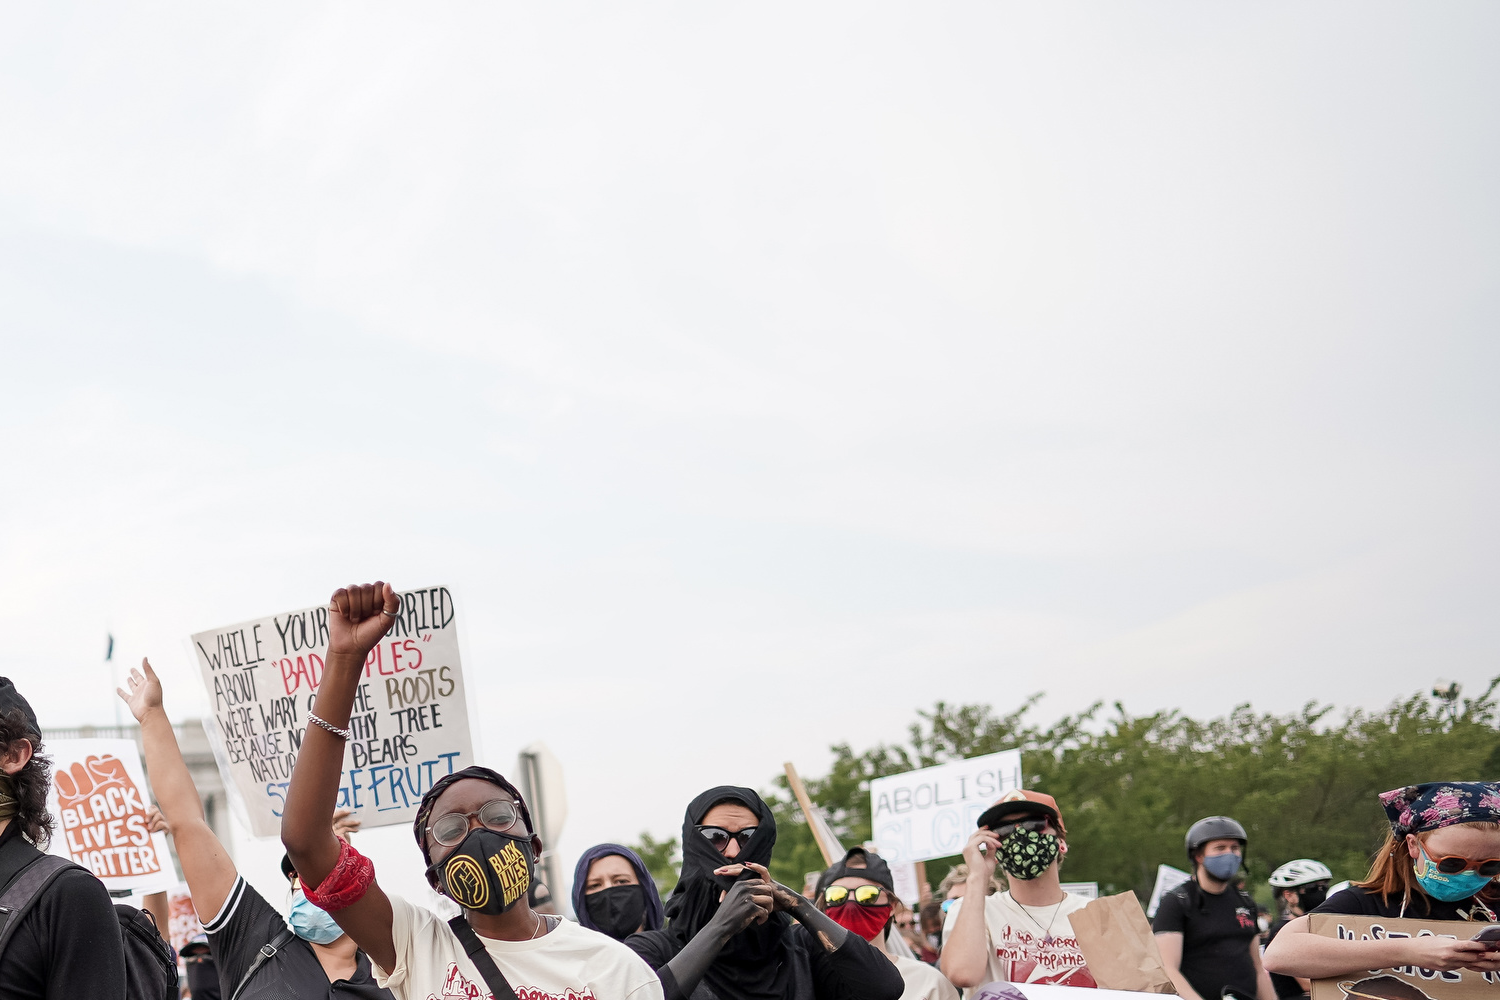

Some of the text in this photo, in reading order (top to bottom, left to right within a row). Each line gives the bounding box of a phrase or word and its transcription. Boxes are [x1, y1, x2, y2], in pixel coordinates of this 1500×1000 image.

[197, 624, 265, 671] WHILE
[213, 665, 258, 711] ABOUT
[260, 694, 298, 732] WARY
[353, 683, 375, 713] HE
[385, 666, 455, 710] ROOTS
[224, 731, 282, 765] BECAUSE
[391, 703, 443, 735] TREE
[351, 734, 418, 769] BEARS
[62, 786, 144, 830] BLACK
[876, 766, 1018, 817] ABOLISH
[66, 814, 150, 853] LIVES
[72, 846, 160, 876] MATTER
[488, 840, 523, 875] BLACK
[498, 856, 529, 889] LIVES
[503, 876, 530, 906] MATTER
[996, 947, 1028, 960] won't
[1060, 952, 1084, 966] the
[1016, 931, 1033, 945] he
